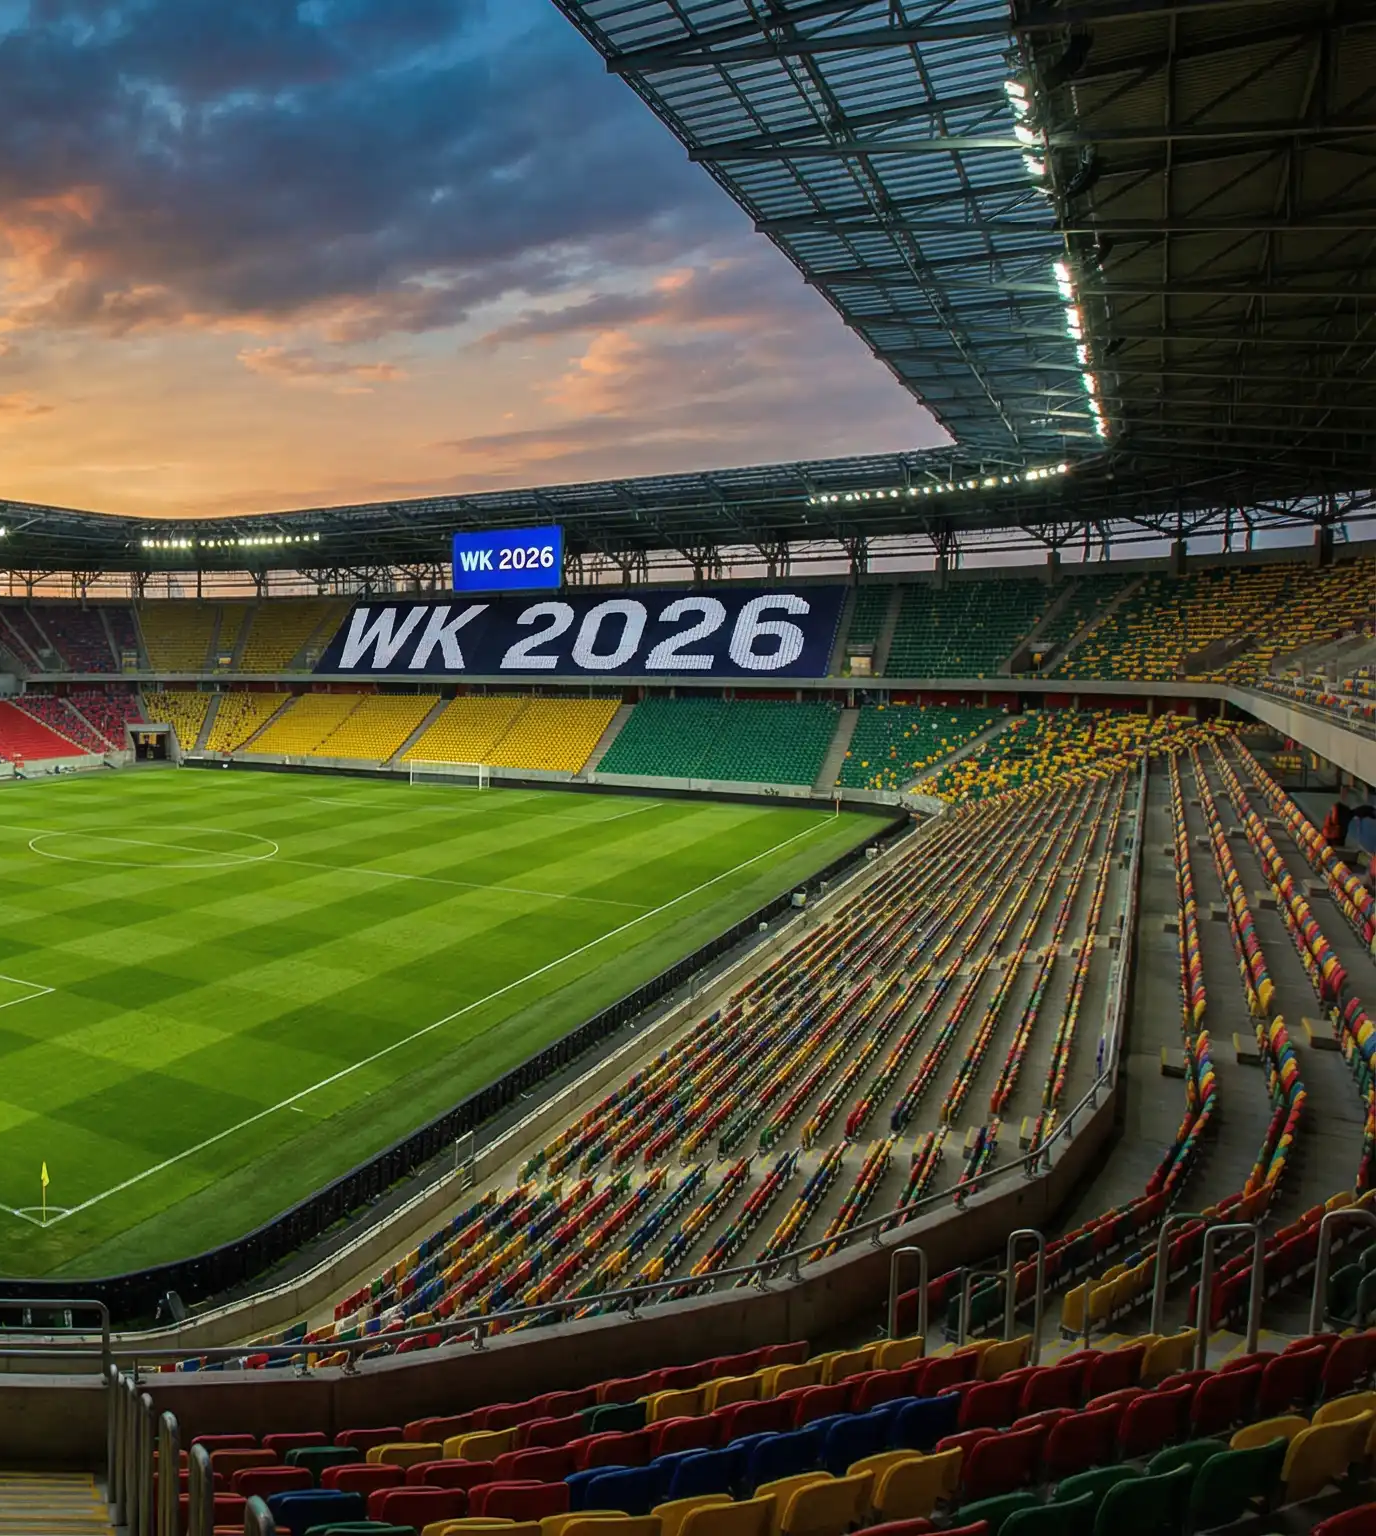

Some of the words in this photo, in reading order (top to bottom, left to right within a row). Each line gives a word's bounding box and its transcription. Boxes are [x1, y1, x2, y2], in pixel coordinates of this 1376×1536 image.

[460, 550, 494, 571] WK
[499, 546, 554, 570] 2026
[338, 604, 489, 669] WK
[499, 594, 810, 670] 2026
